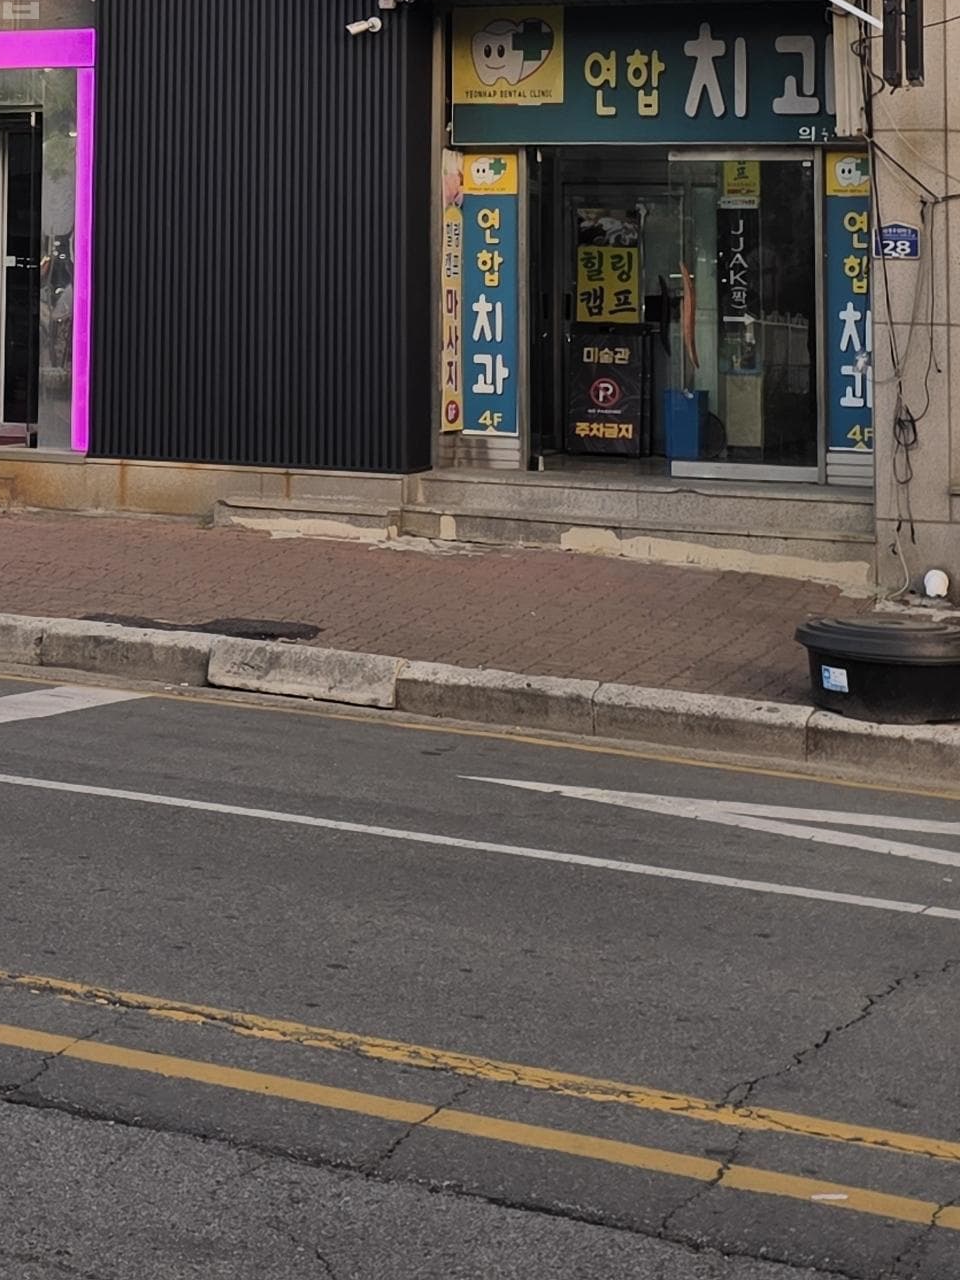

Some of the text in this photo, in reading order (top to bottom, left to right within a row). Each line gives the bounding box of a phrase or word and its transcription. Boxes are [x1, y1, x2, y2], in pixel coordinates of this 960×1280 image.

[500, 89, 527, 99] DENTAL
[530, 89, 553, 98] CLINIC
[882, 240, 912, 256] 28
[580, 249, 634, 283] 힐링
[579, 285, 637, 318] 캠프
[445, 288, 459, 392] 마사지
[583, 346, 631, 365] 미술관
[478, 410, 503, 427] 4F
[575, 421, 633, 440] 주차금지
